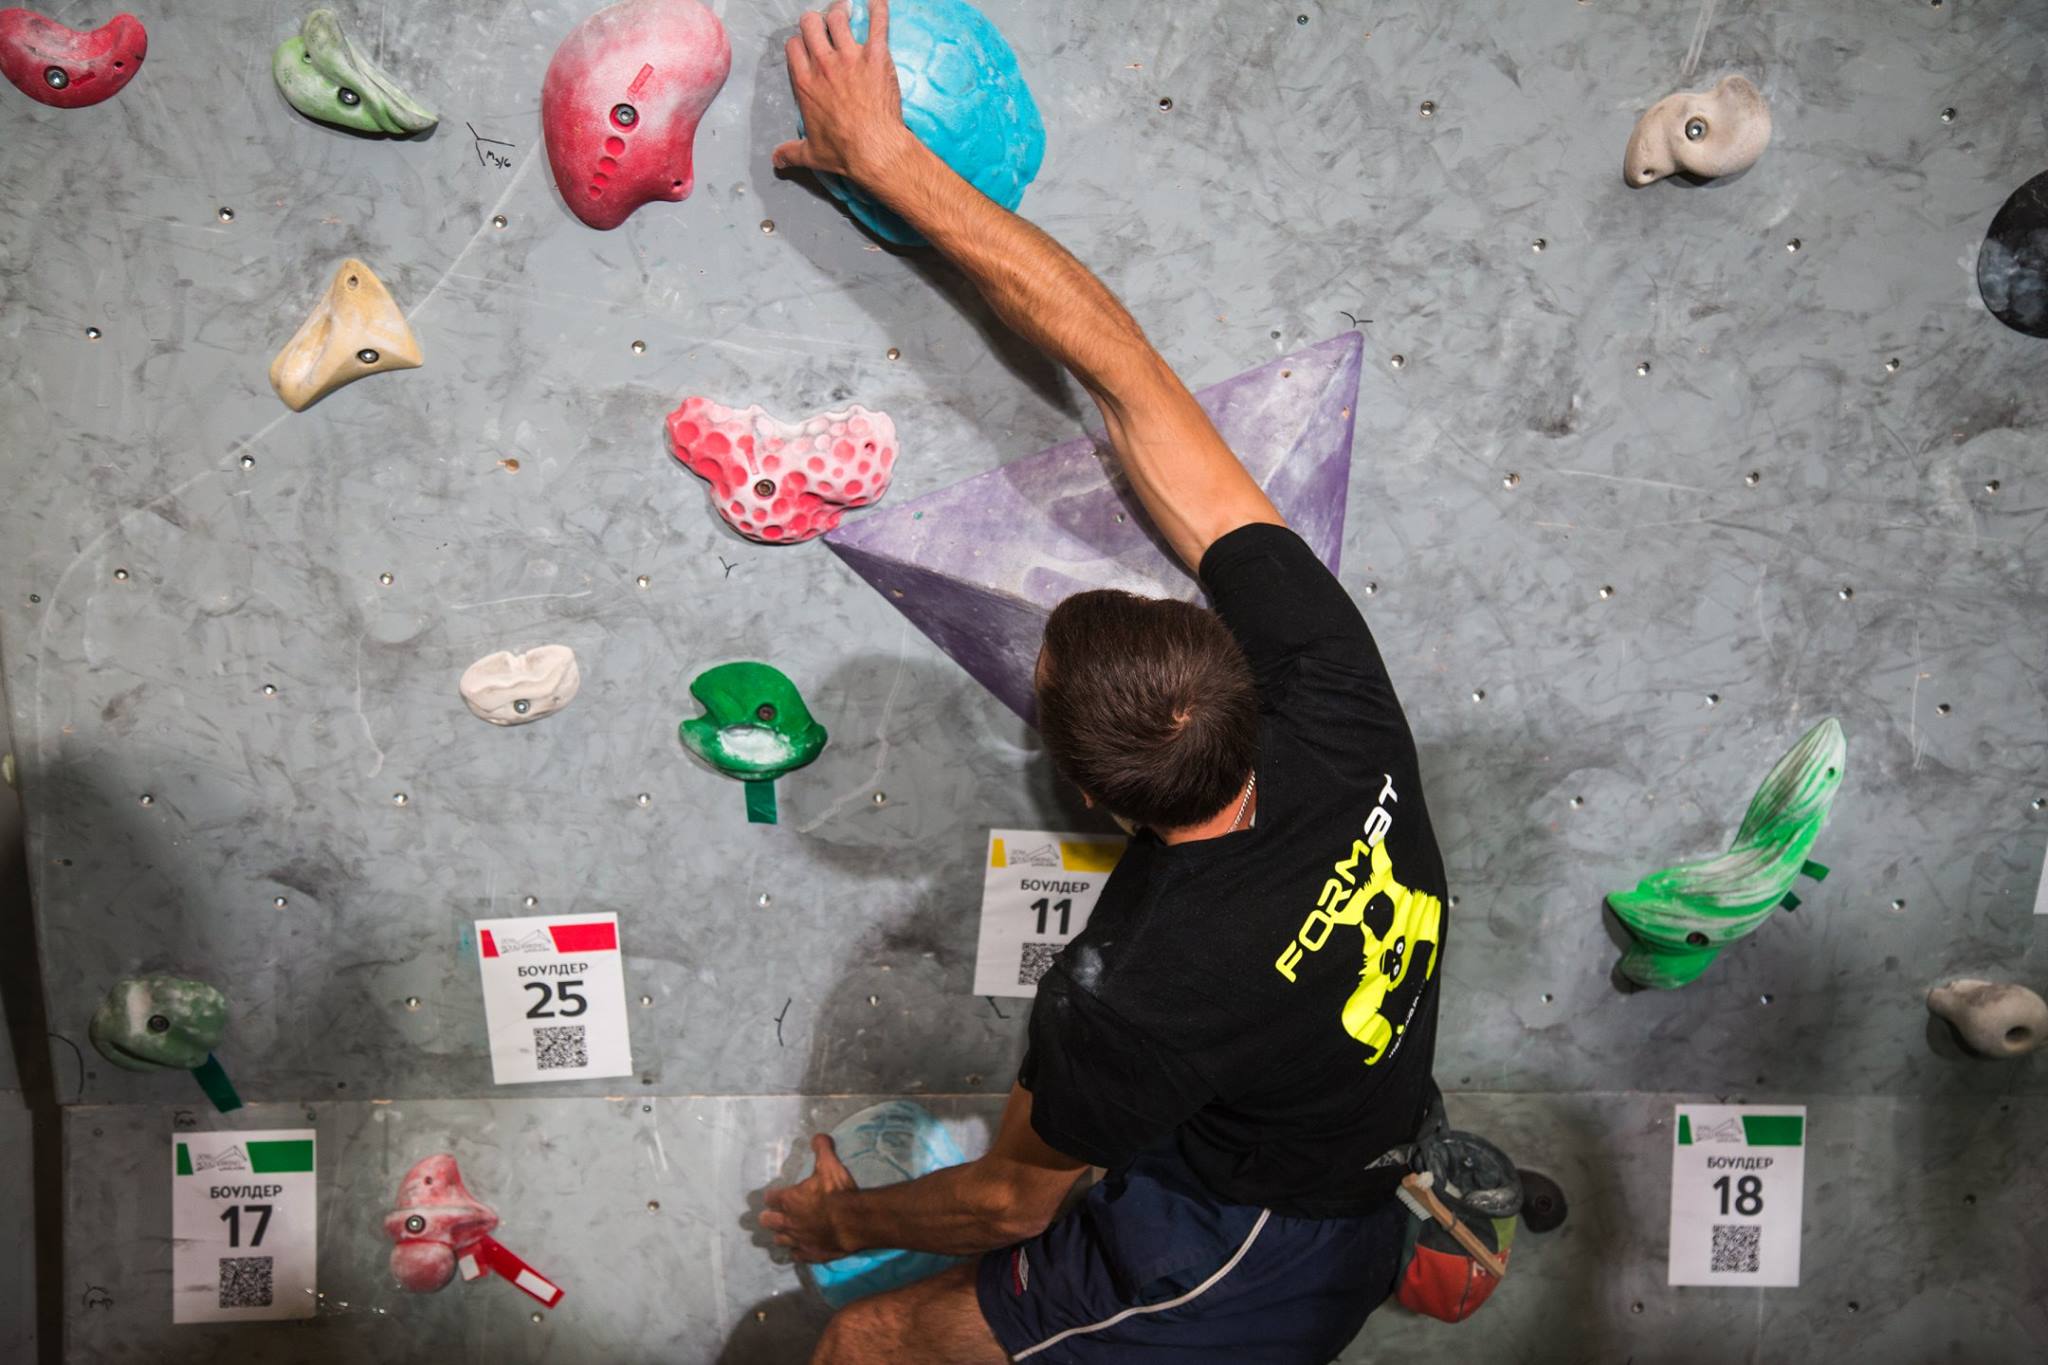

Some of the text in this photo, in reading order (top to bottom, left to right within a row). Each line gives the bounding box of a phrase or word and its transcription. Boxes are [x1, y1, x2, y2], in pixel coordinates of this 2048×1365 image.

[1020, 879, 1090, 895] БОУЛДЕР
[1030, 897, 1072, 935] 11
[518, 963, 588, 977] БОУЛДЕР
[524, 980, 588, 1019] 25
[1707, 1157, 1774, 1170] БОУЛДЕР
[210, 1185, 283, 1200] БОУЛДЕР
[1713, 1175, 1764, 1217] 18
[220, 1204, 273, 1248] 17
